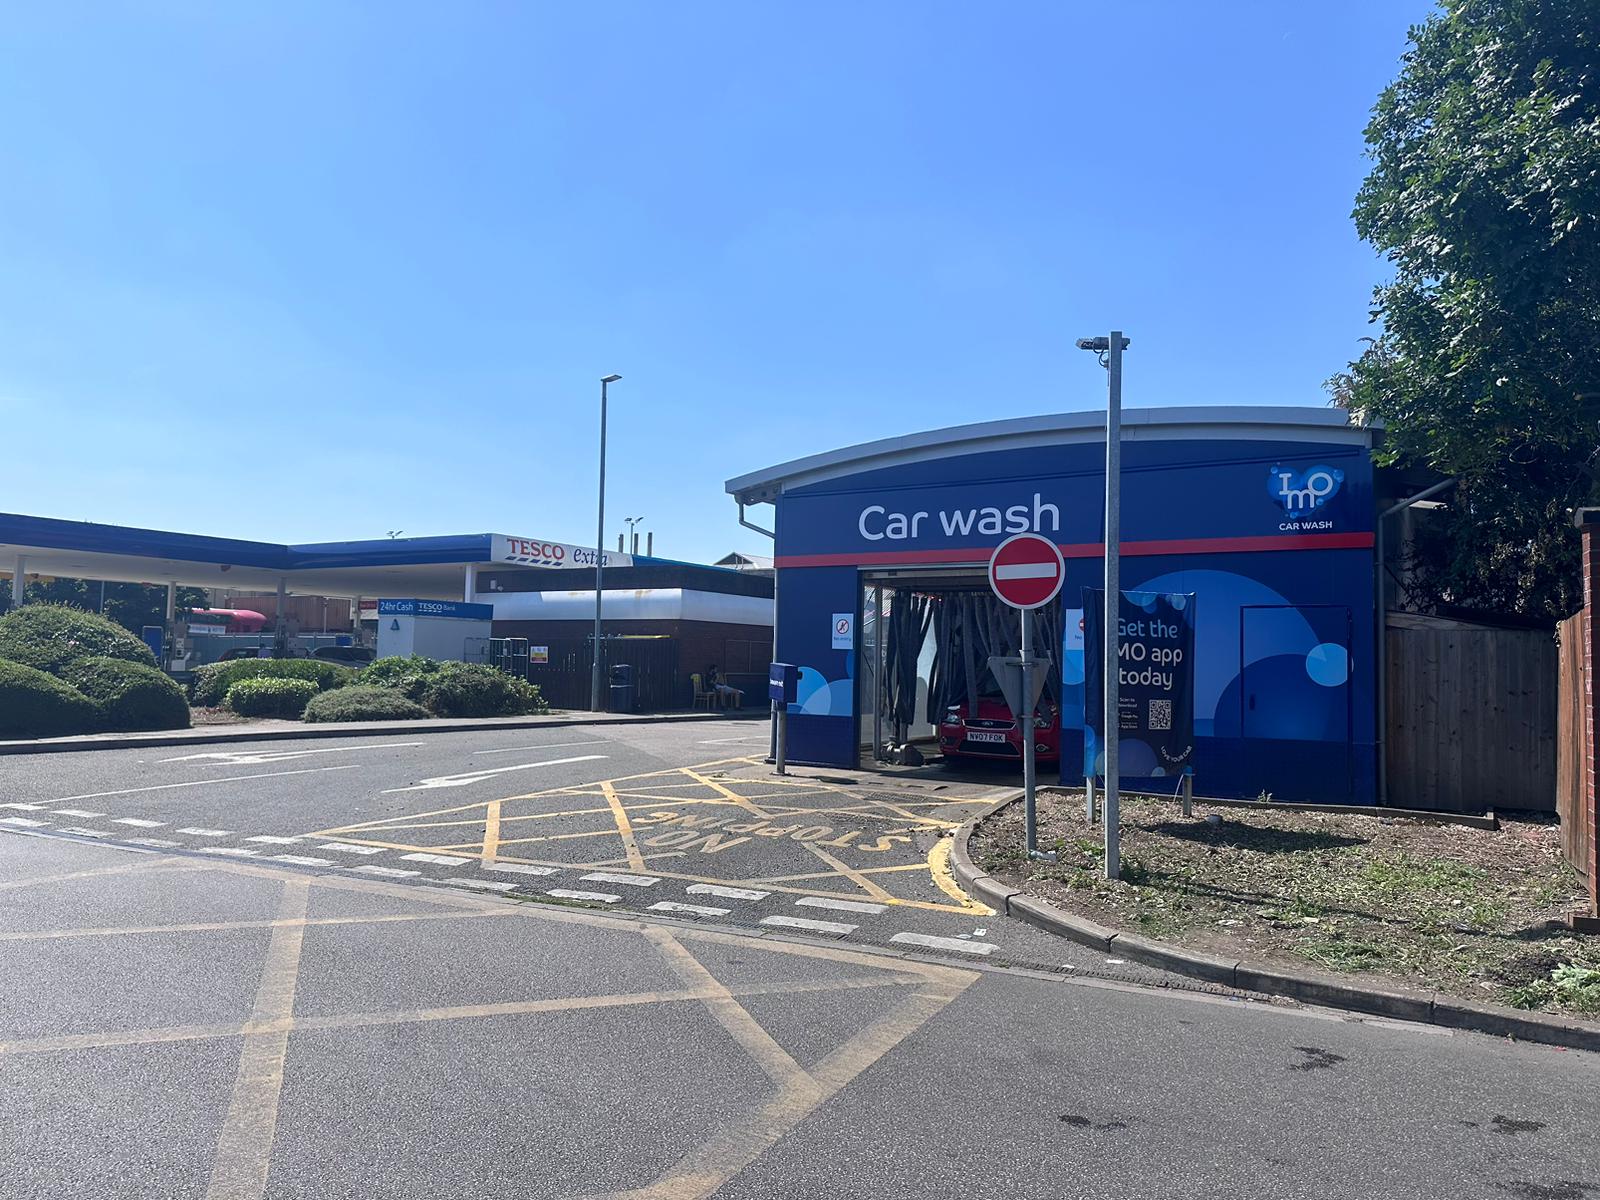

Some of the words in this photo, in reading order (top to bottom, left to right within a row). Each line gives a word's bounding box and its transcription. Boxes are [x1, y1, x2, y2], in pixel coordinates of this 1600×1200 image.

[858, 504, 928, 540] Car
[939, 493, 1060, 536] wash
[1279, 522, 1300, 531] CAR
[1301, 521, 1333, 530] WASH
[506, 537, 565, 561] TESCO
[573, 548, 608, 566] exta
[380, 602, 396, 611] 24hr
[396, 602, 414, 612] Cash
[418, 602, 443, 611] TESCO
[1118, 618, 1145, 637] Get
[1150, 619, 1178, 638] the
[1151, 648, 1183, 667] app
[1119, 666, 1173, 690] today
[631, 811, 912, 852] STOPPING
[644, 830, 753, 853] NO
